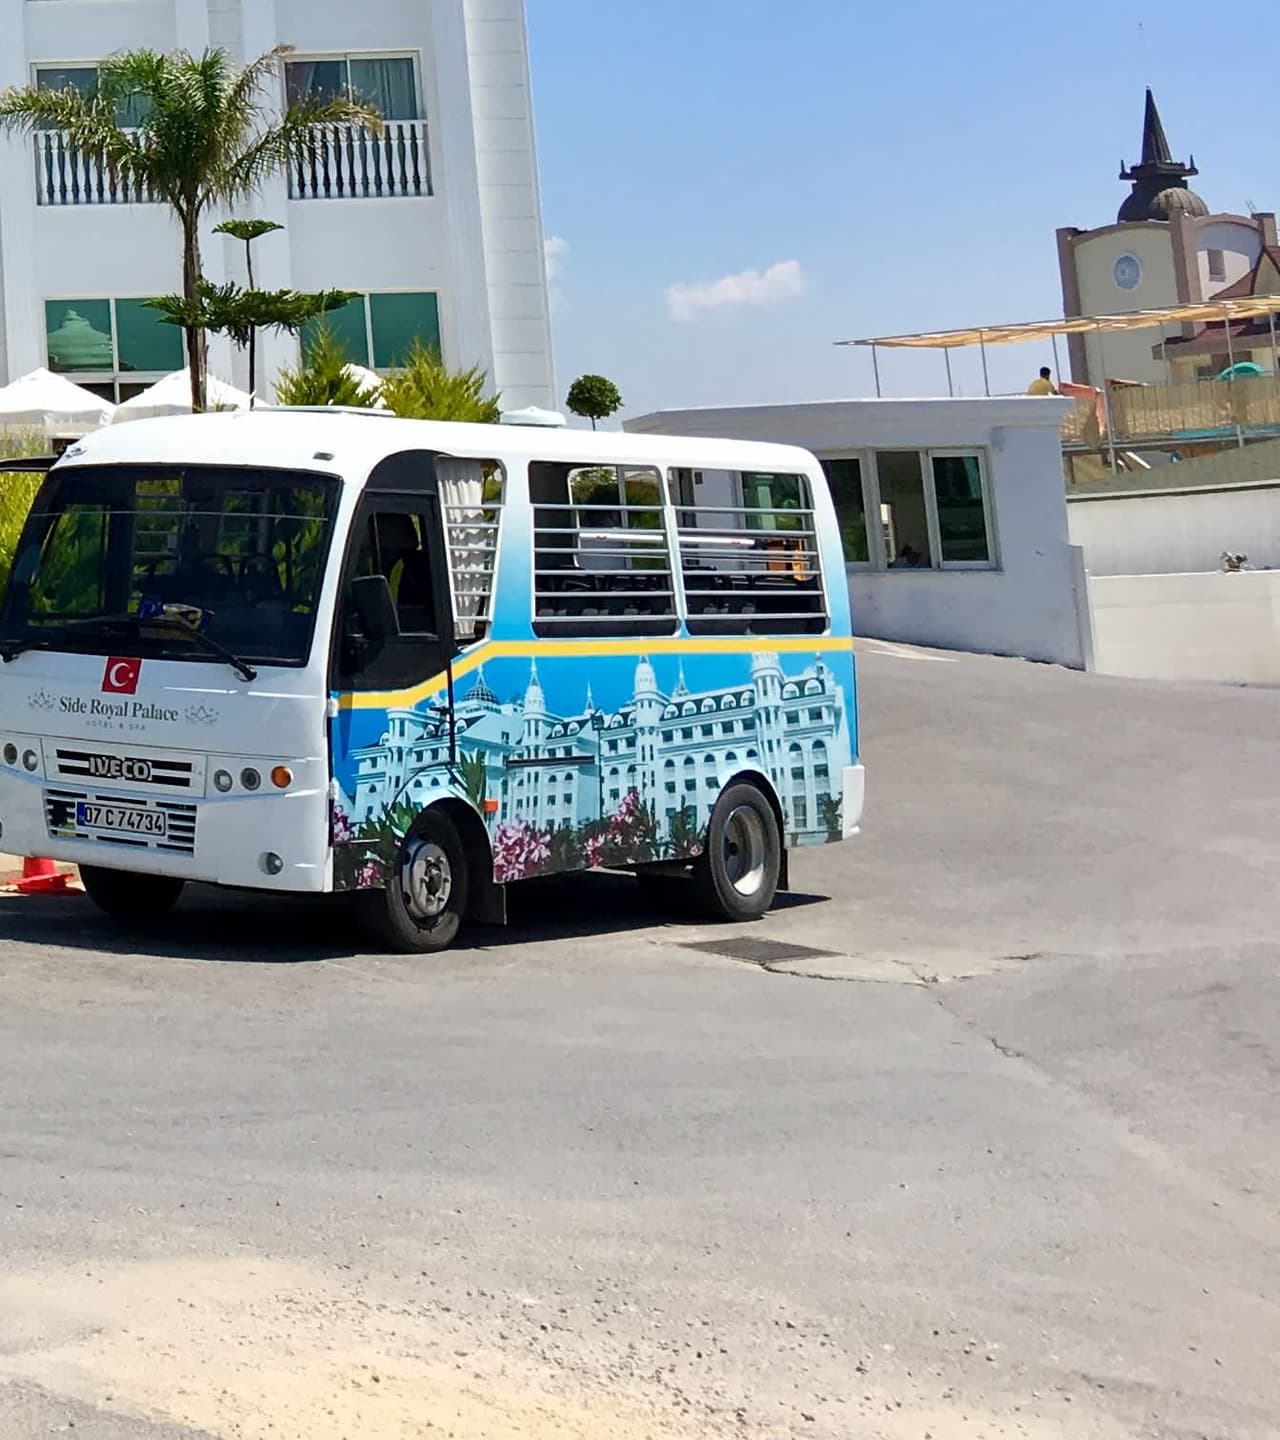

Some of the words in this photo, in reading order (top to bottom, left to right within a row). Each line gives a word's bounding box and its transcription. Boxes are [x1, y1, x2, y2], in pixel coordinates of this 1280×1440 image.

[59, 695, 88, 714] Side
[90, 698, 129, 720] Royal
[132, 703, 179, 722] Palace
[89, 757, 150, 779] IVECO
[85, 806, 101, 824] 07
[105, 809, 114, 826] C
[118, 810, 163, 832] 74734
